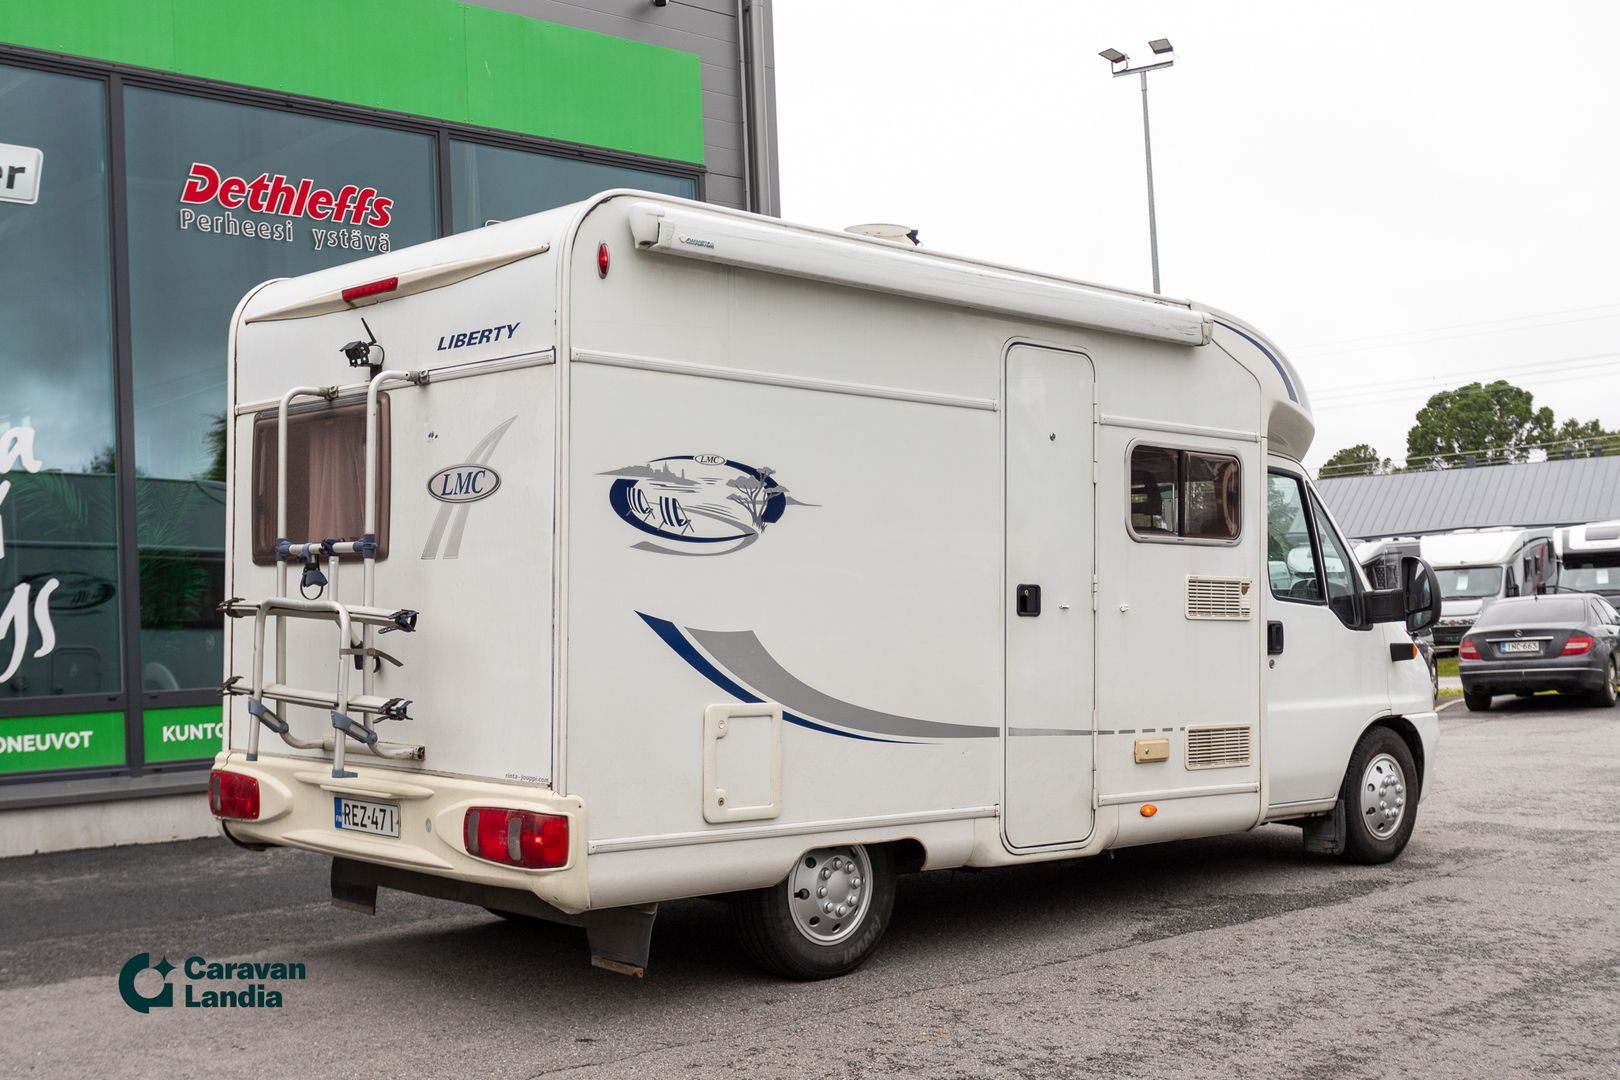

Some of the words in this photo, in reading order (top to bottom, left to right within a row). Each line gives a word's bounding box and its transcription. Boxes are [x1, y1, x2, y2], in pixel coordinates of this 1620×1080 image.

[179, 162, 394, 228] Dethleffs
[180, 208, 294, 242] Perheesi
[312, 228, 391, 254] ystävä
[437, 321, 521, 351] LIBERTY
[700, 455, 720, 464] LMC
[441, 470, 486, 496] LMC
[343, 803, 394, 833] REZ-471
